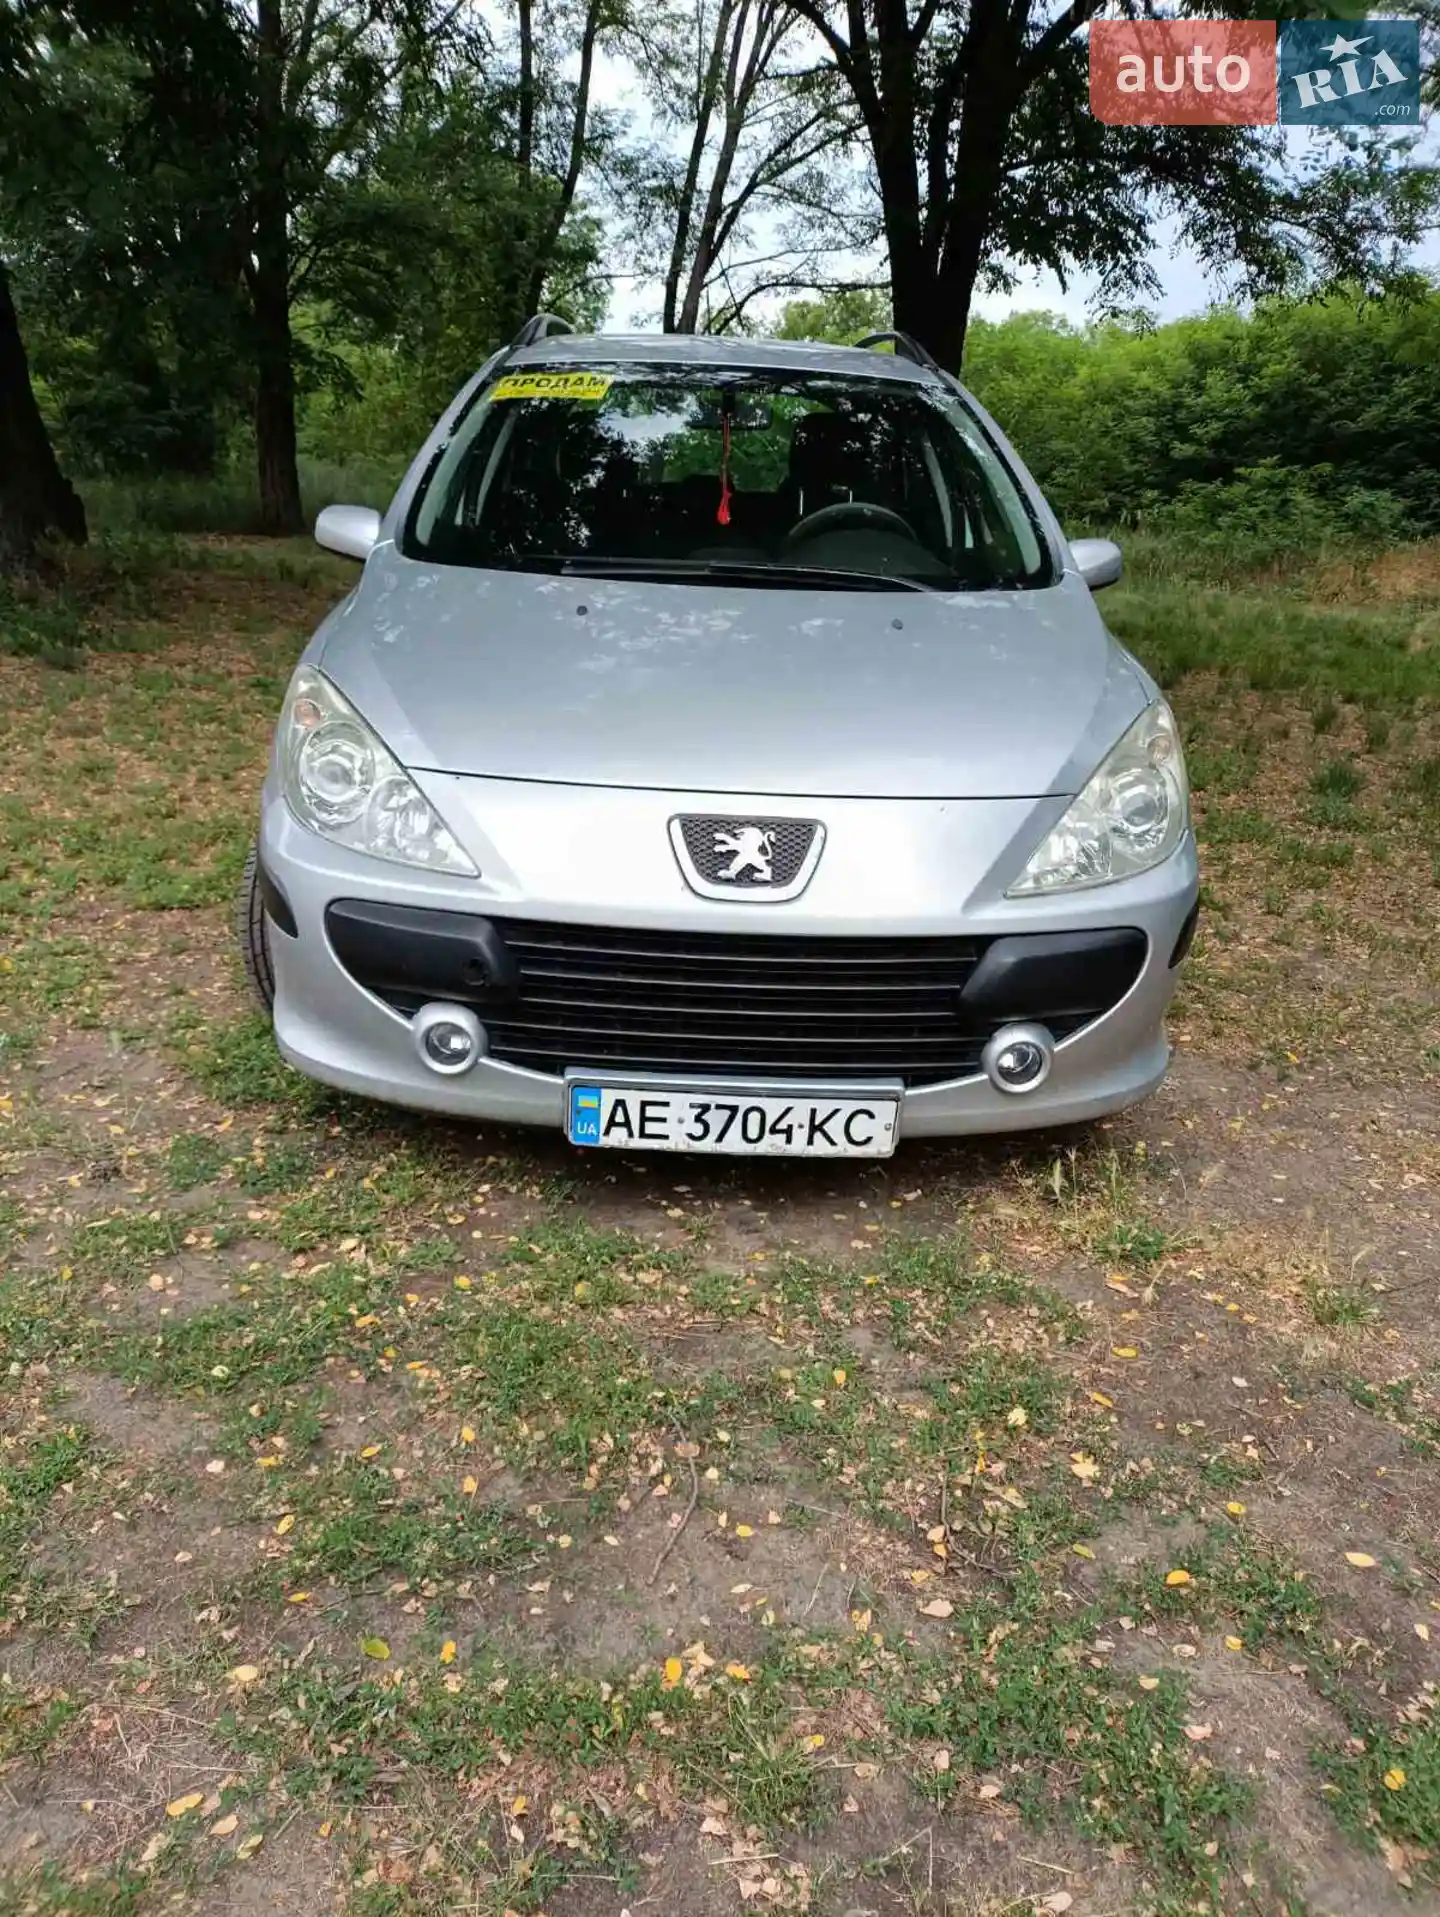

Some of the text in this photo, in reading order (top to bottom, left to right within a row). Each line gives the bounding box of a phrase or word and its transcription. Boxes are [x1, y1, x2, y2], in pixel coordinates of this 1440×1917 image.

[501, 375, 607, 390] ПРОДАМ
[577, 1121, 598, 1136] UA
[602, 1098, 877, 1147] AE 3704 KC
